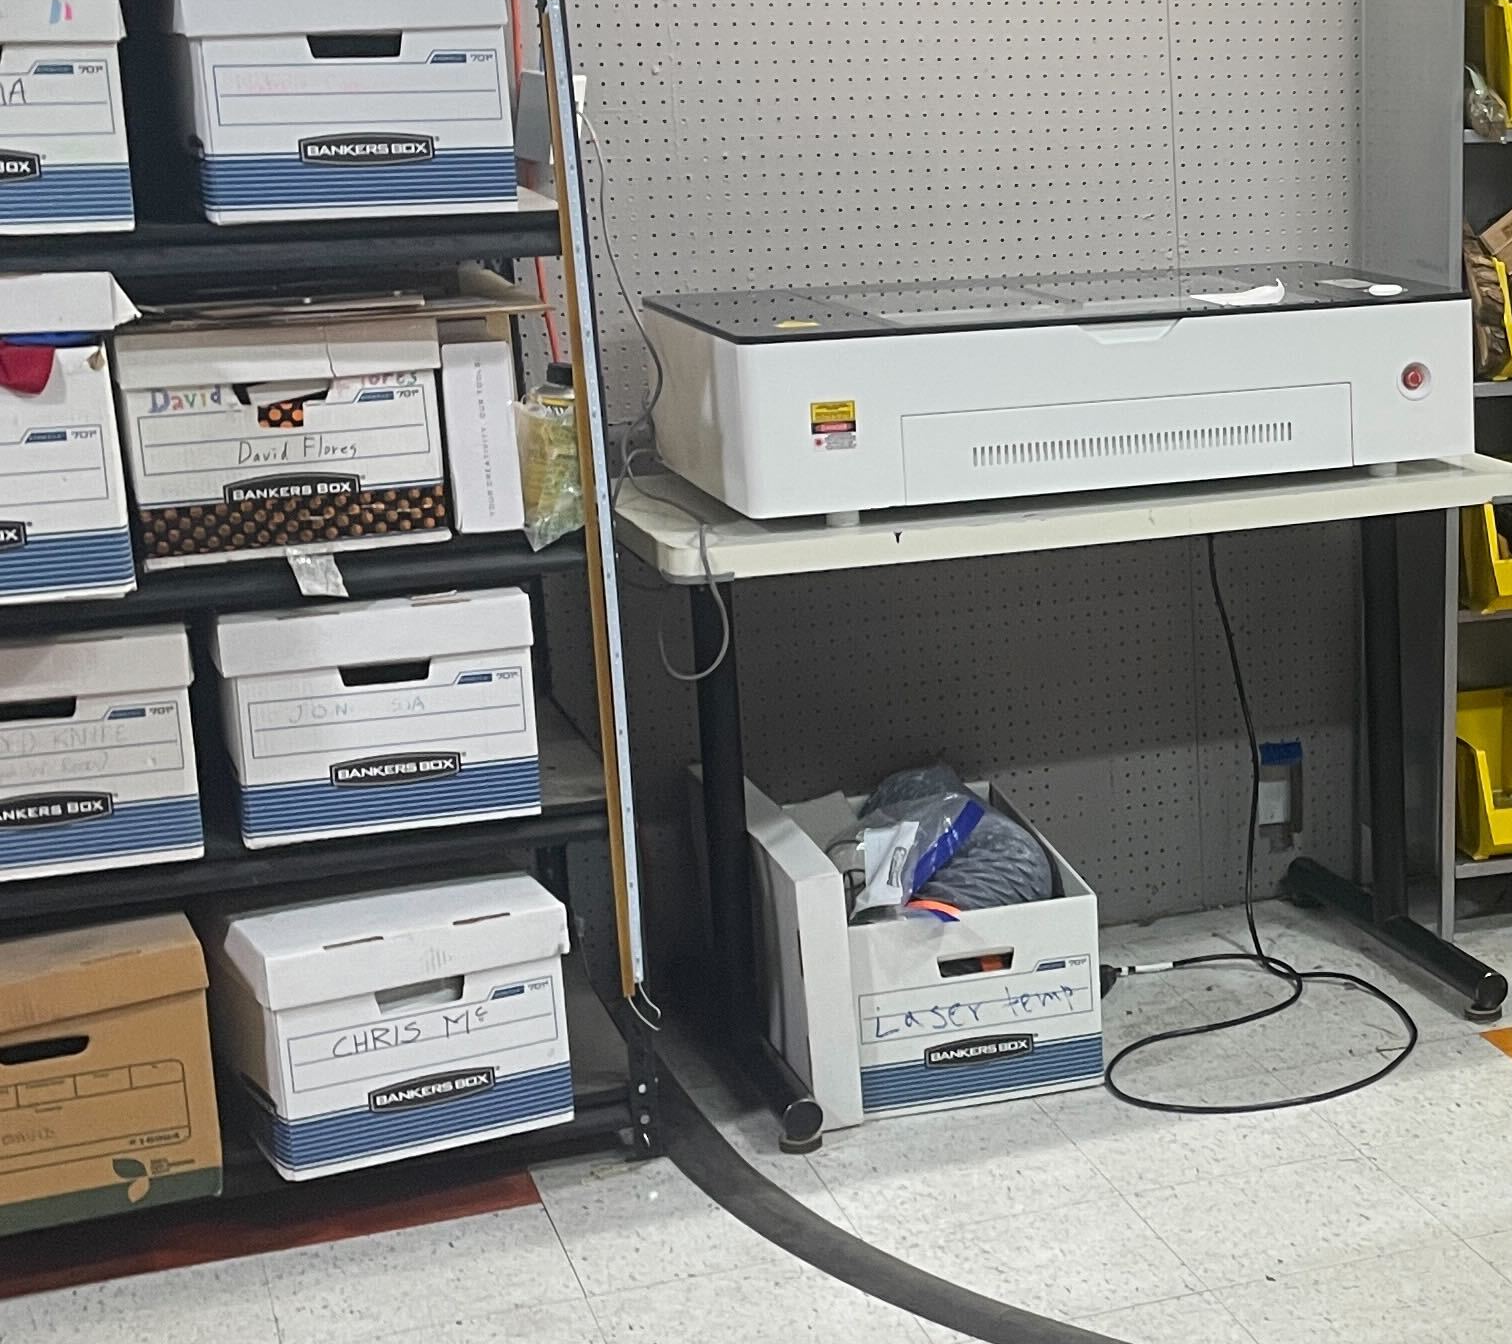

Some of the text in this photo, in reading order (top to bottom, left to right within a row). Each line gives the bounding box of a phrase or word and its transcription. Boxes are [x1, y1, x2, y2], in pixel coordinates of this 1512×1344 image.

[307, 141, 428, 157] BANKERS BOX
[150, 385, 222, 413] David
[238, 435, 357, 465] David Flores
[233, 480, 352, 501] BANKERS BOX
[338, 757, 455, 780] BANKERS BOX
[66, 799, 104, 814] BOX
[333, 1022, 421, 1058] CHRIS
[931, 1038, 1029, 1063] BANKERS BOX
[375, 1073, 490, 1107] BANKERS BOX
